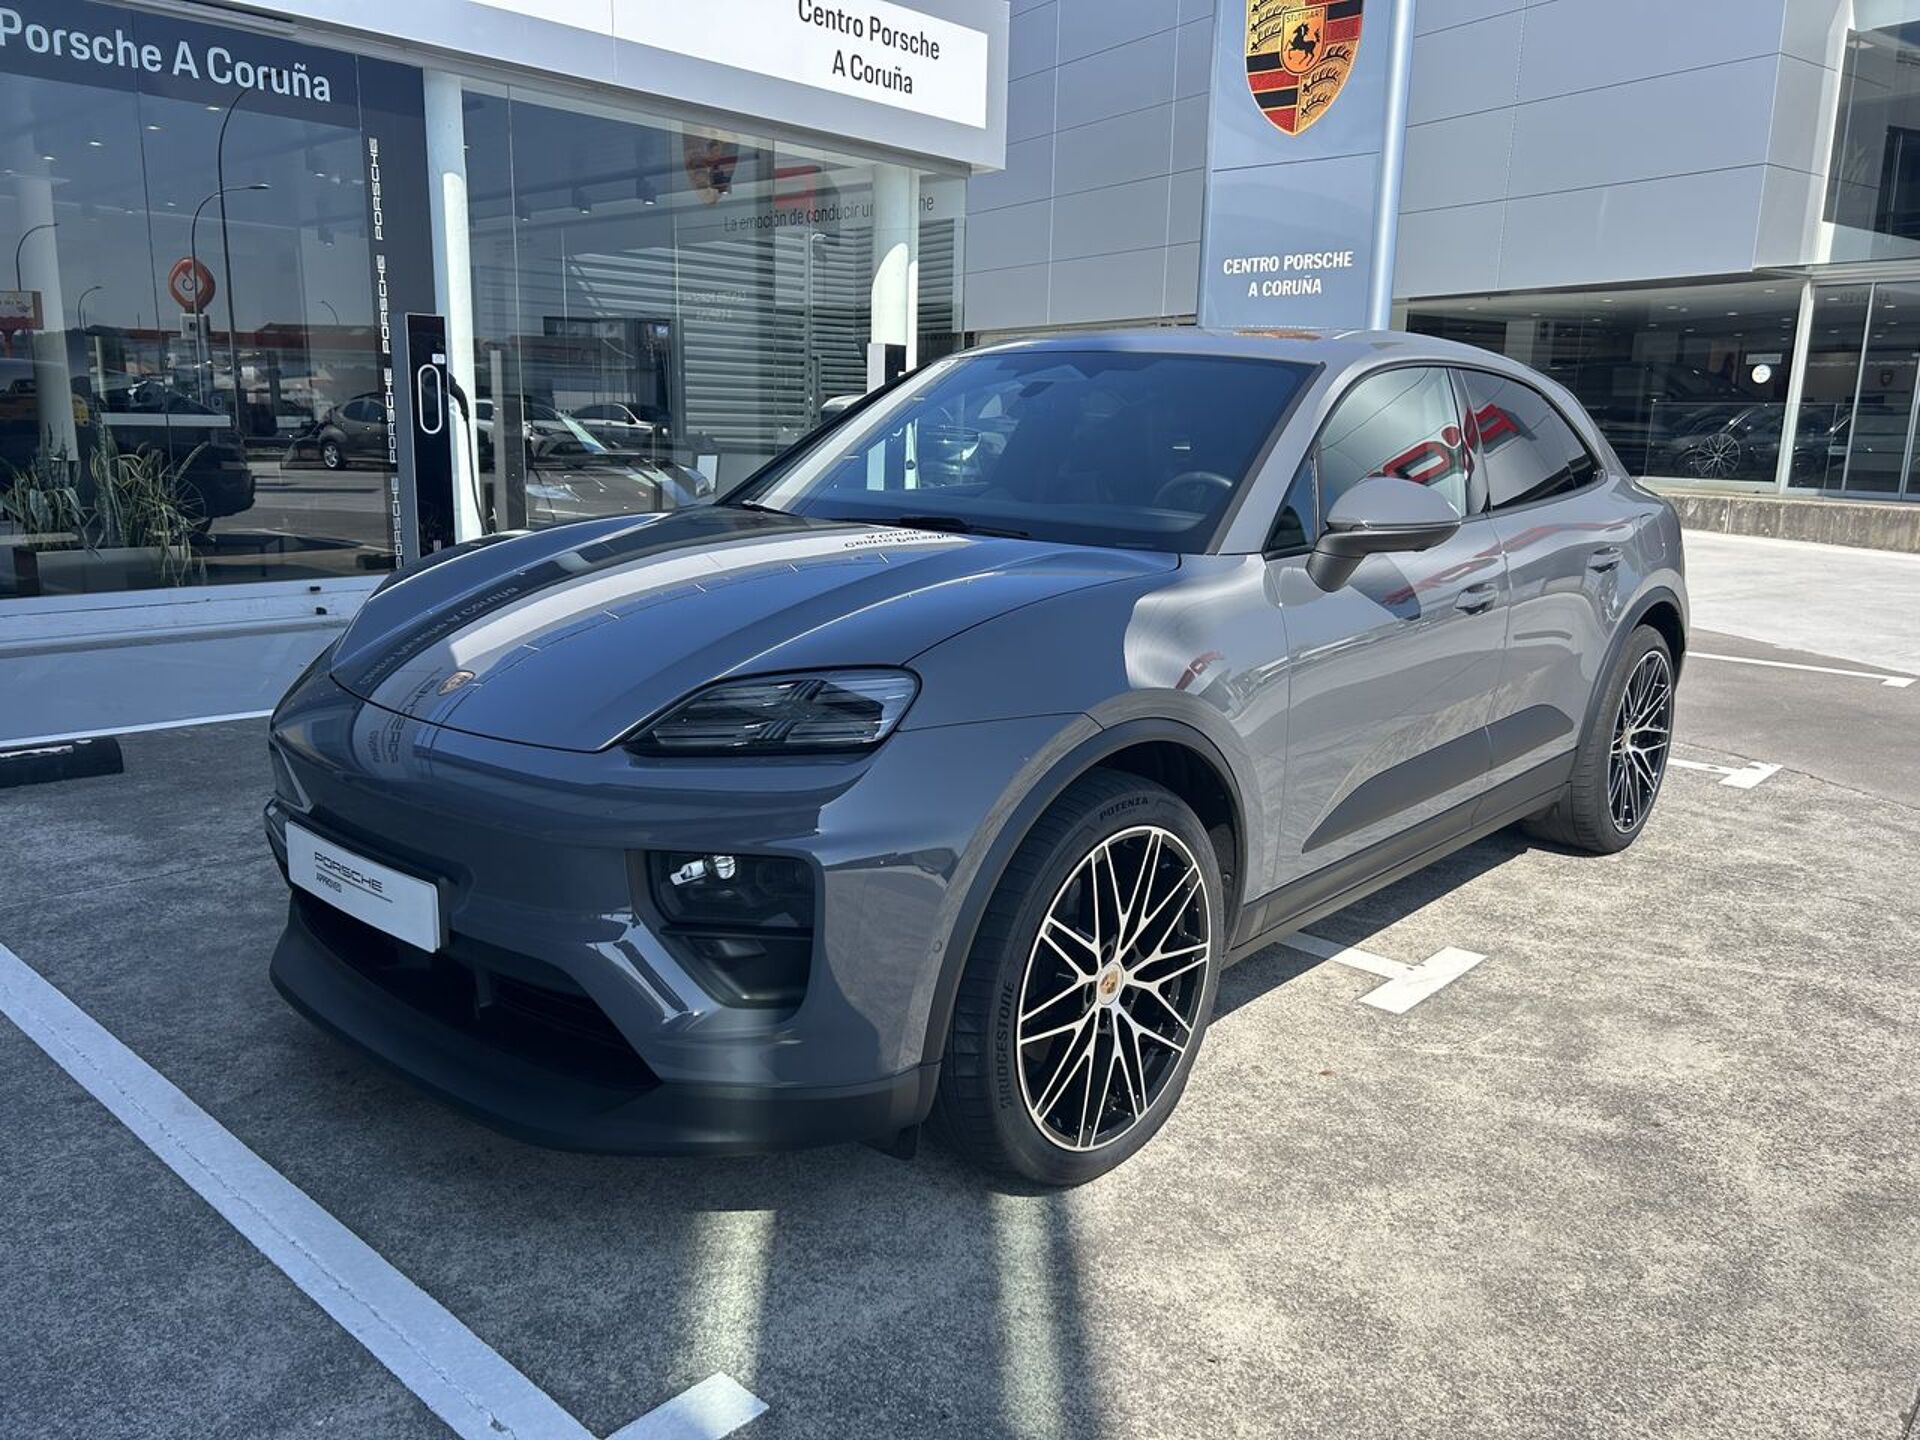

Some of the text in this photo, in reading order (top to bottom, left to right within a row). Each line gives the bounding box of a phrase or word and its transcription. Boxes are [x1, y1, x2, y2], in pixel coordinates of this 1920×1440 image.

[798, 0, 940, 60] Centro Porsche
[0, 8, 332, 102] Porsche A Coruña
[832, 49, 913, 94] A Coruña
[368, 137, 384, 241] PORSCHE
[723, 216, 737, 232] La
[739, 211, 787, 230] emoción
[789, 208, 804, 225] de
[806, 202, 862, 223] conducir
[1223, 251, 1354, 275] CENTRO PORSCHE
[376, 254, 391, 355] PORSCHE
[1248, 275, 1322, 297] A CORUÑA
[383, 368, 398, 465] PORSCHE
[1100, 797, 1149, 820] POTENZA
[314, 851, 383, 893] PORSCHE
